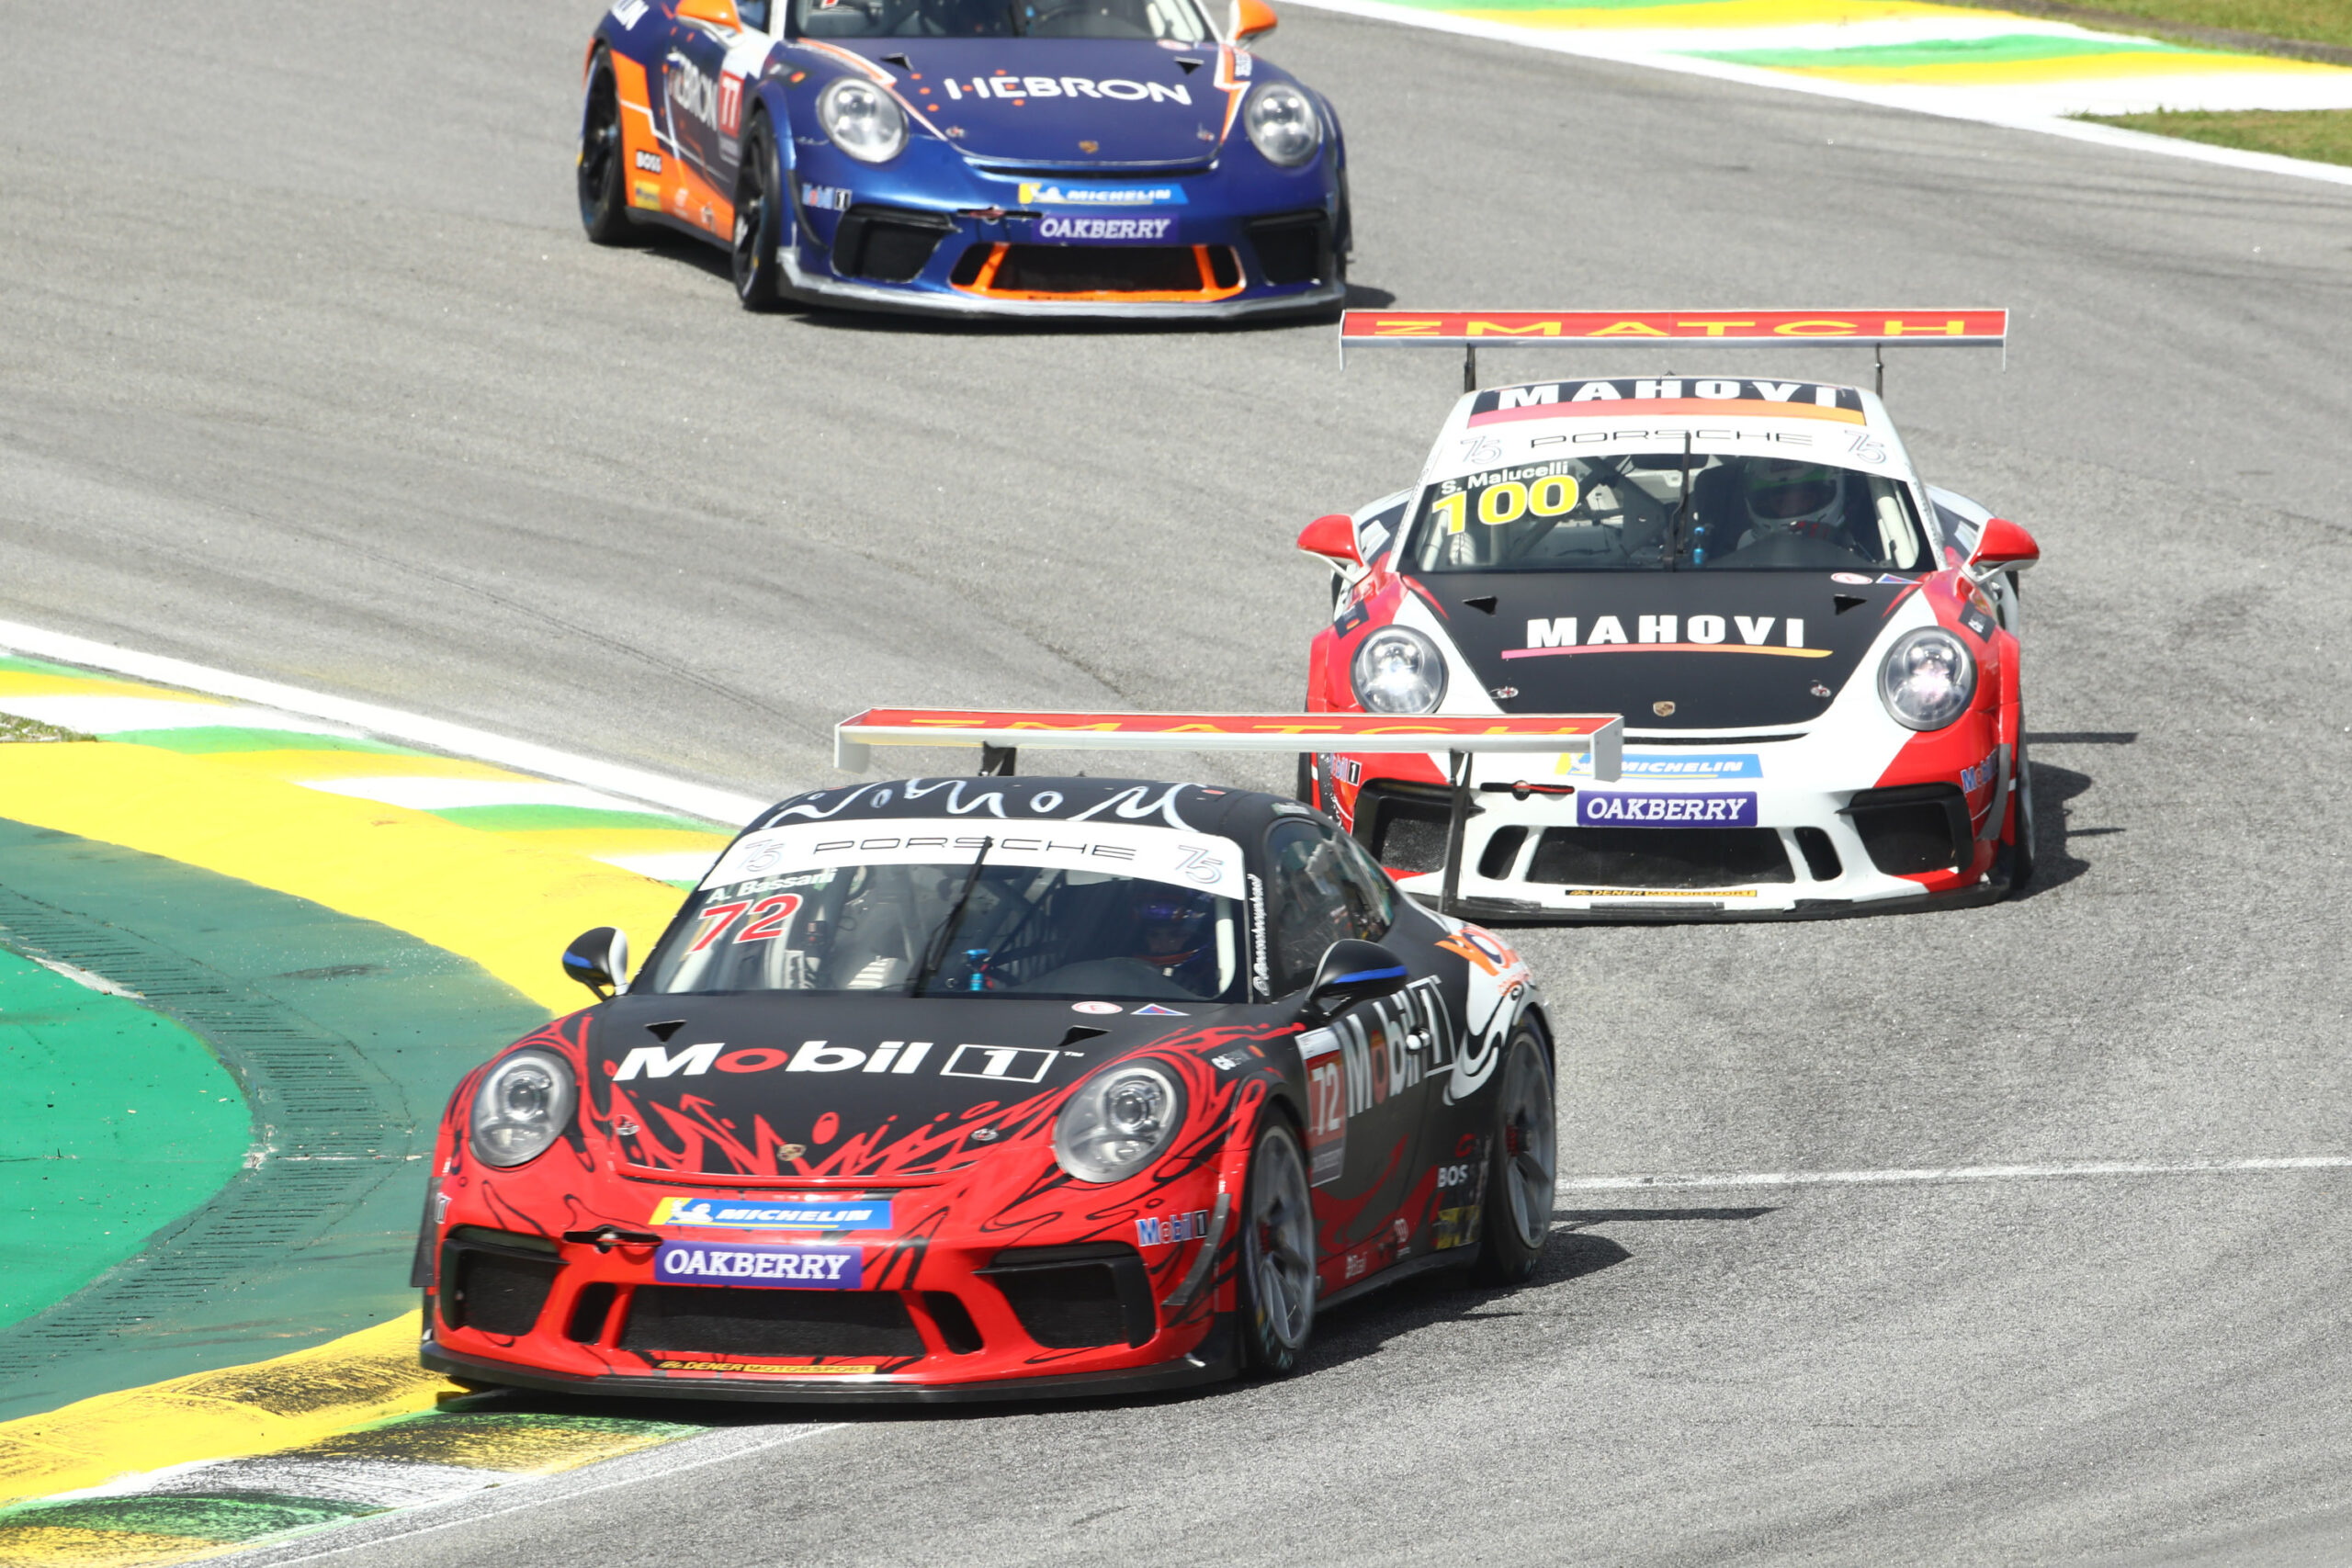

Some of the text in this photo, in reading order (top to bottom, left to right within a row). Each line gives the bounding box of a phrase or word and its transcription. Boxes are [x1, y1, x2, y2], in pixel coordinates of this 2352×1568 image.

[944, 76, 1192, 106] HEBRON
[1067, 189, 1171, 201] MICHELIN
[1039, 218, 1171, 239] OAKBERRY
[1374, 321, 1964, 336] ZMATCH
[1498, 380, 1837, 410] MAHOVI
[1531, 429, 1813, 448] PORSCHE
[1442, 479, 1463, 495] S.
[1467, 460, 1568, 490] Malucelli
[1431, 474, 1579, 536] 100
[1527, 615, 1804, 649] MAHOVI
[1587, 797, 1747, 820] OAKBERRY
[813, 837, 1136, 861] PORSCHE
[685, 893, 804, 956] 72
[612, 1040, 933, 1082] Mobil
[1310, 1062, 1340, 1136] 72
[716, 1209, 873, 1222] MICHELIN
[663, 1249, 852, 1280] OAKBERRY
[683, 1361, 743, 1371] DENER
